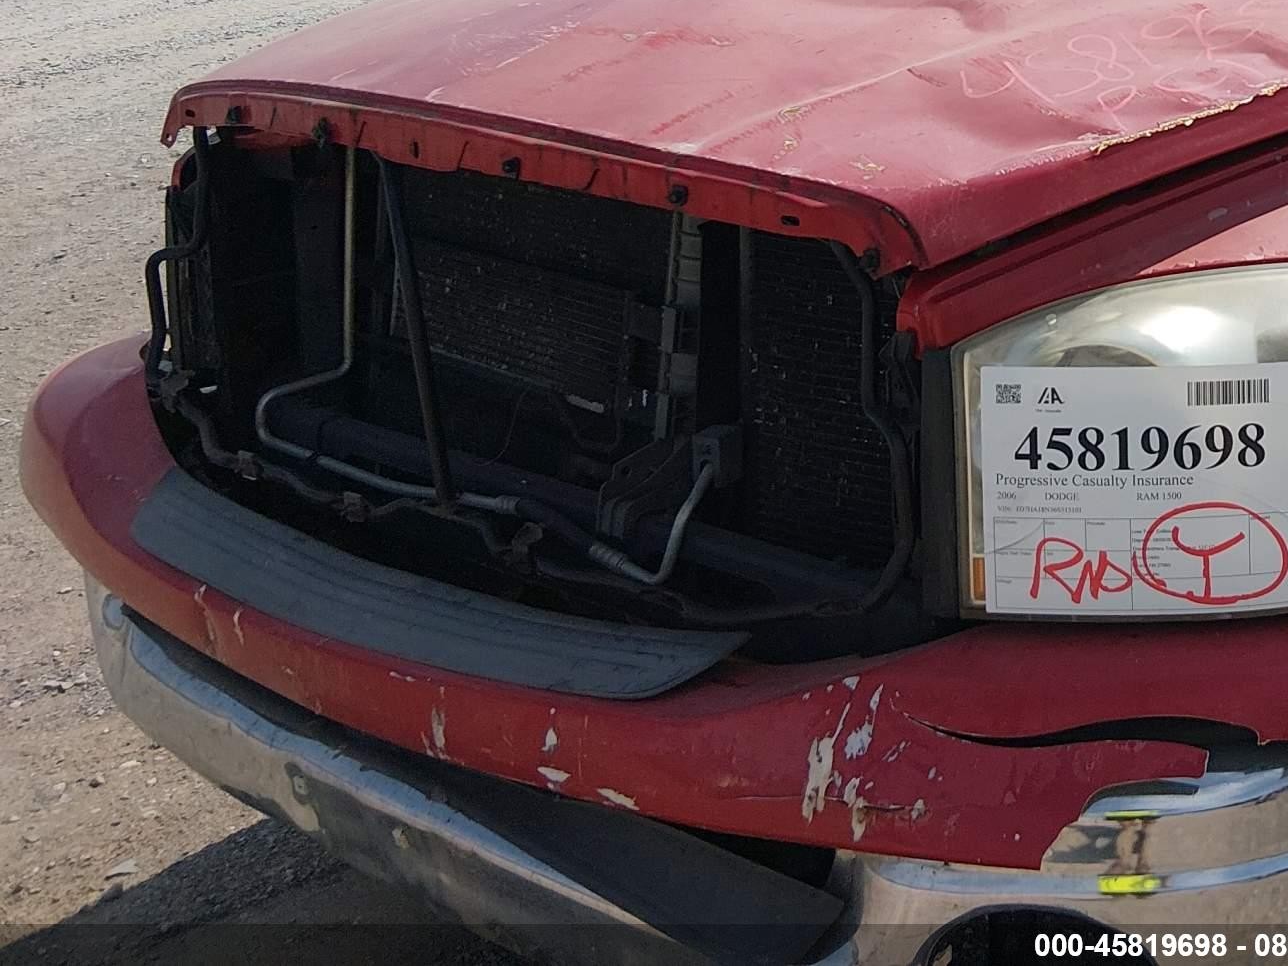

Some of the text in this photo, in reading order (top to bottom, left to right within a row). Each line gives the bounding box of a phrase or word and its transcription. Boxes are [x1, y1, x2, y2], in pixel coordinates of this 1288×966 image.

[1014, 422, 1266, 472] 45819698
[995, 473, 1194, 489] Progressive Casualty Insurance
[997, 491, 1182, 501] 2006 DODGE RAM 1500
